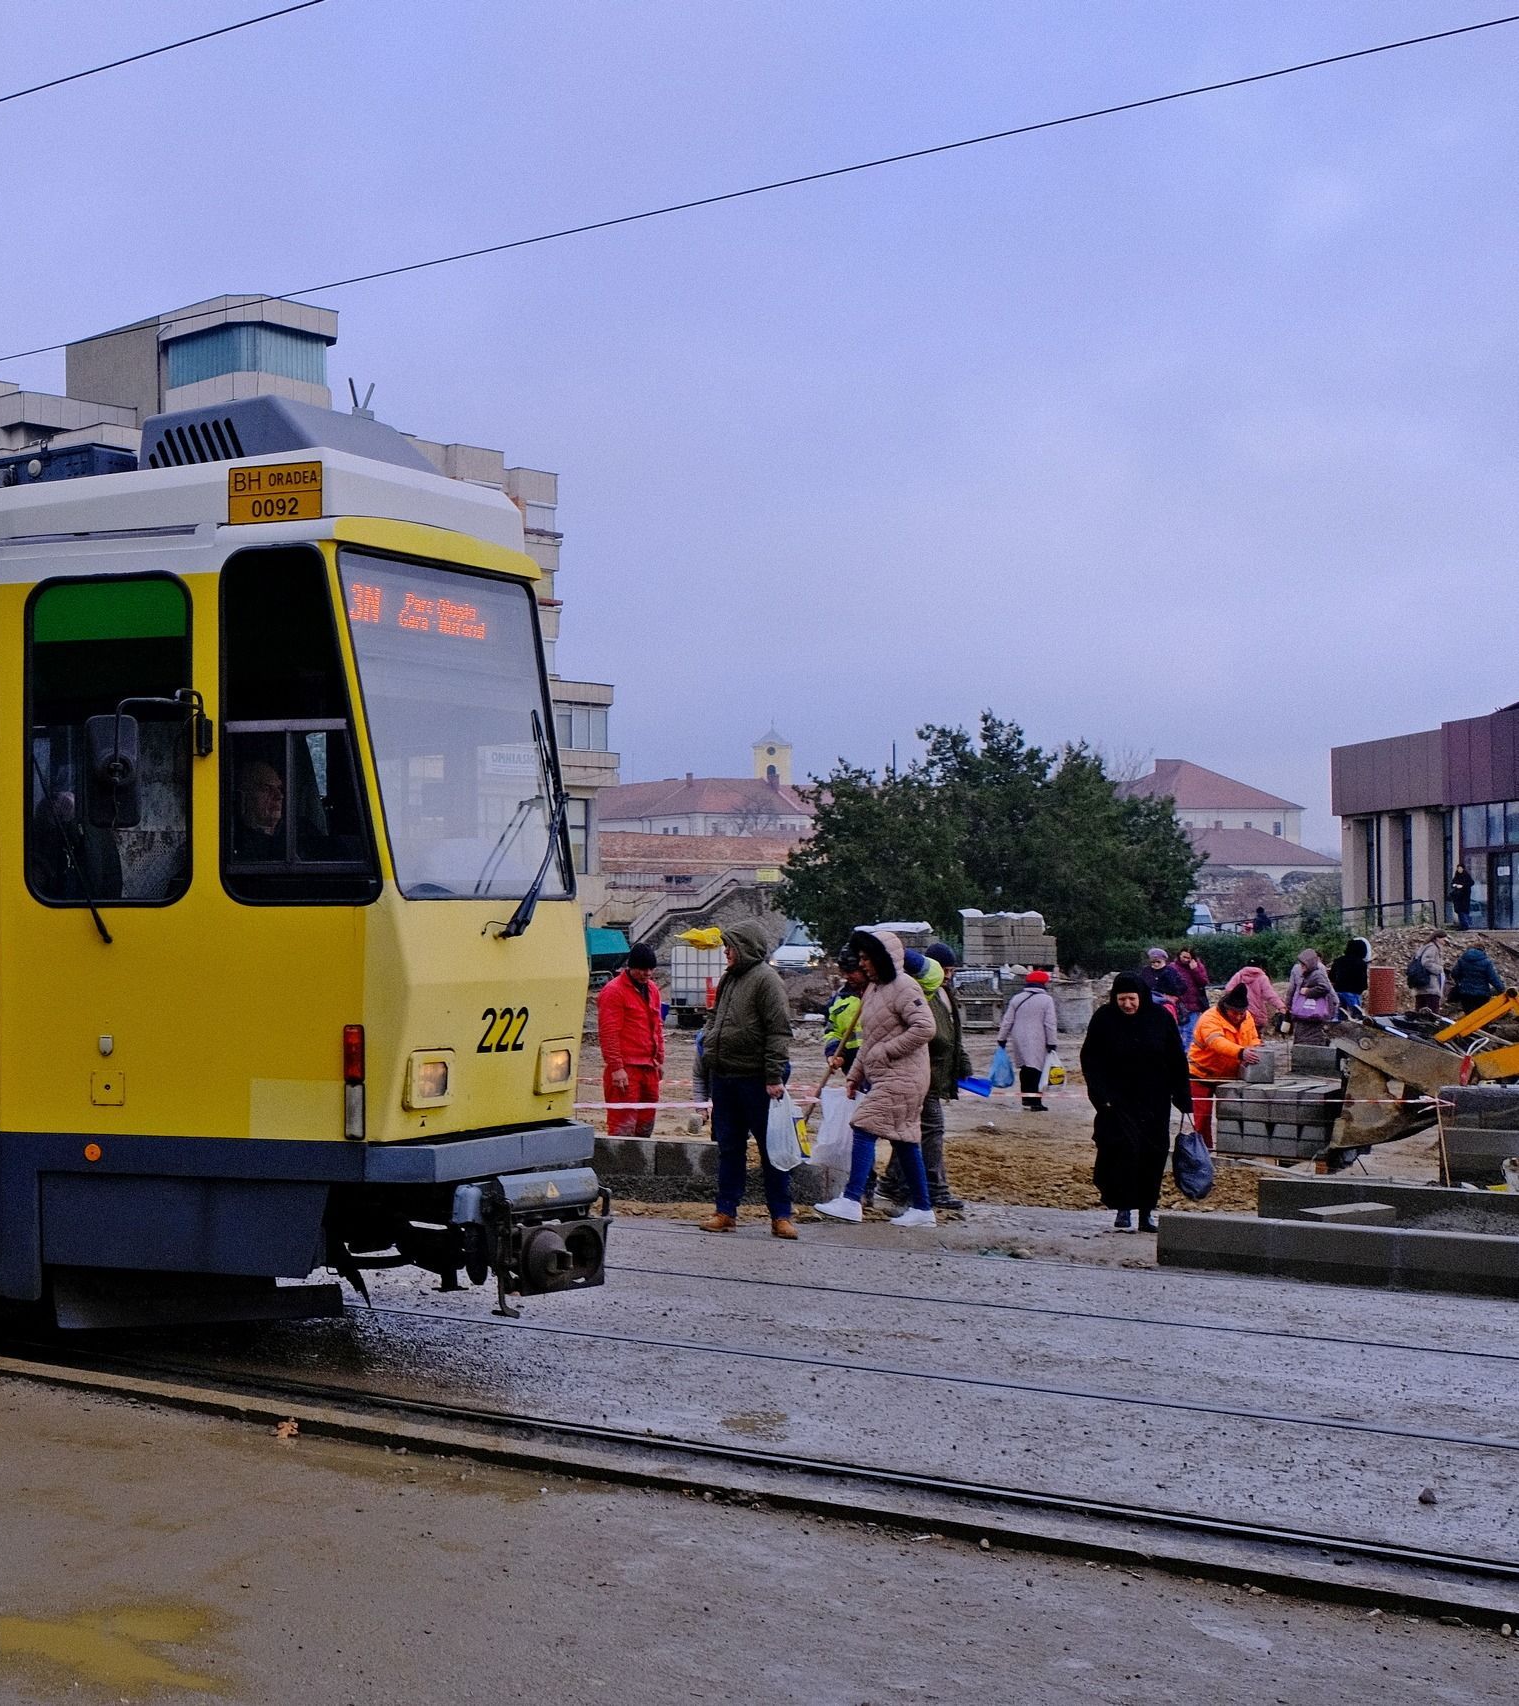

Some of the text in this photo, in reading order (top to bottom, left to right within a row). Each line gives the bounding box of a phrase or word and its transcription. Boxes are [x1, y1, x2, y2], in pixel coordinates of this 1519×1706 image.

[234, 470, 318, 491] BH ORADEA
[252, 497, 299, 518] 0092
[349, 583, 381, 623] 3N
[404, 591, 435, 614] Parc
[398, 608, 429, 630] Gara
[476, 1006, 529, 1053] 222
